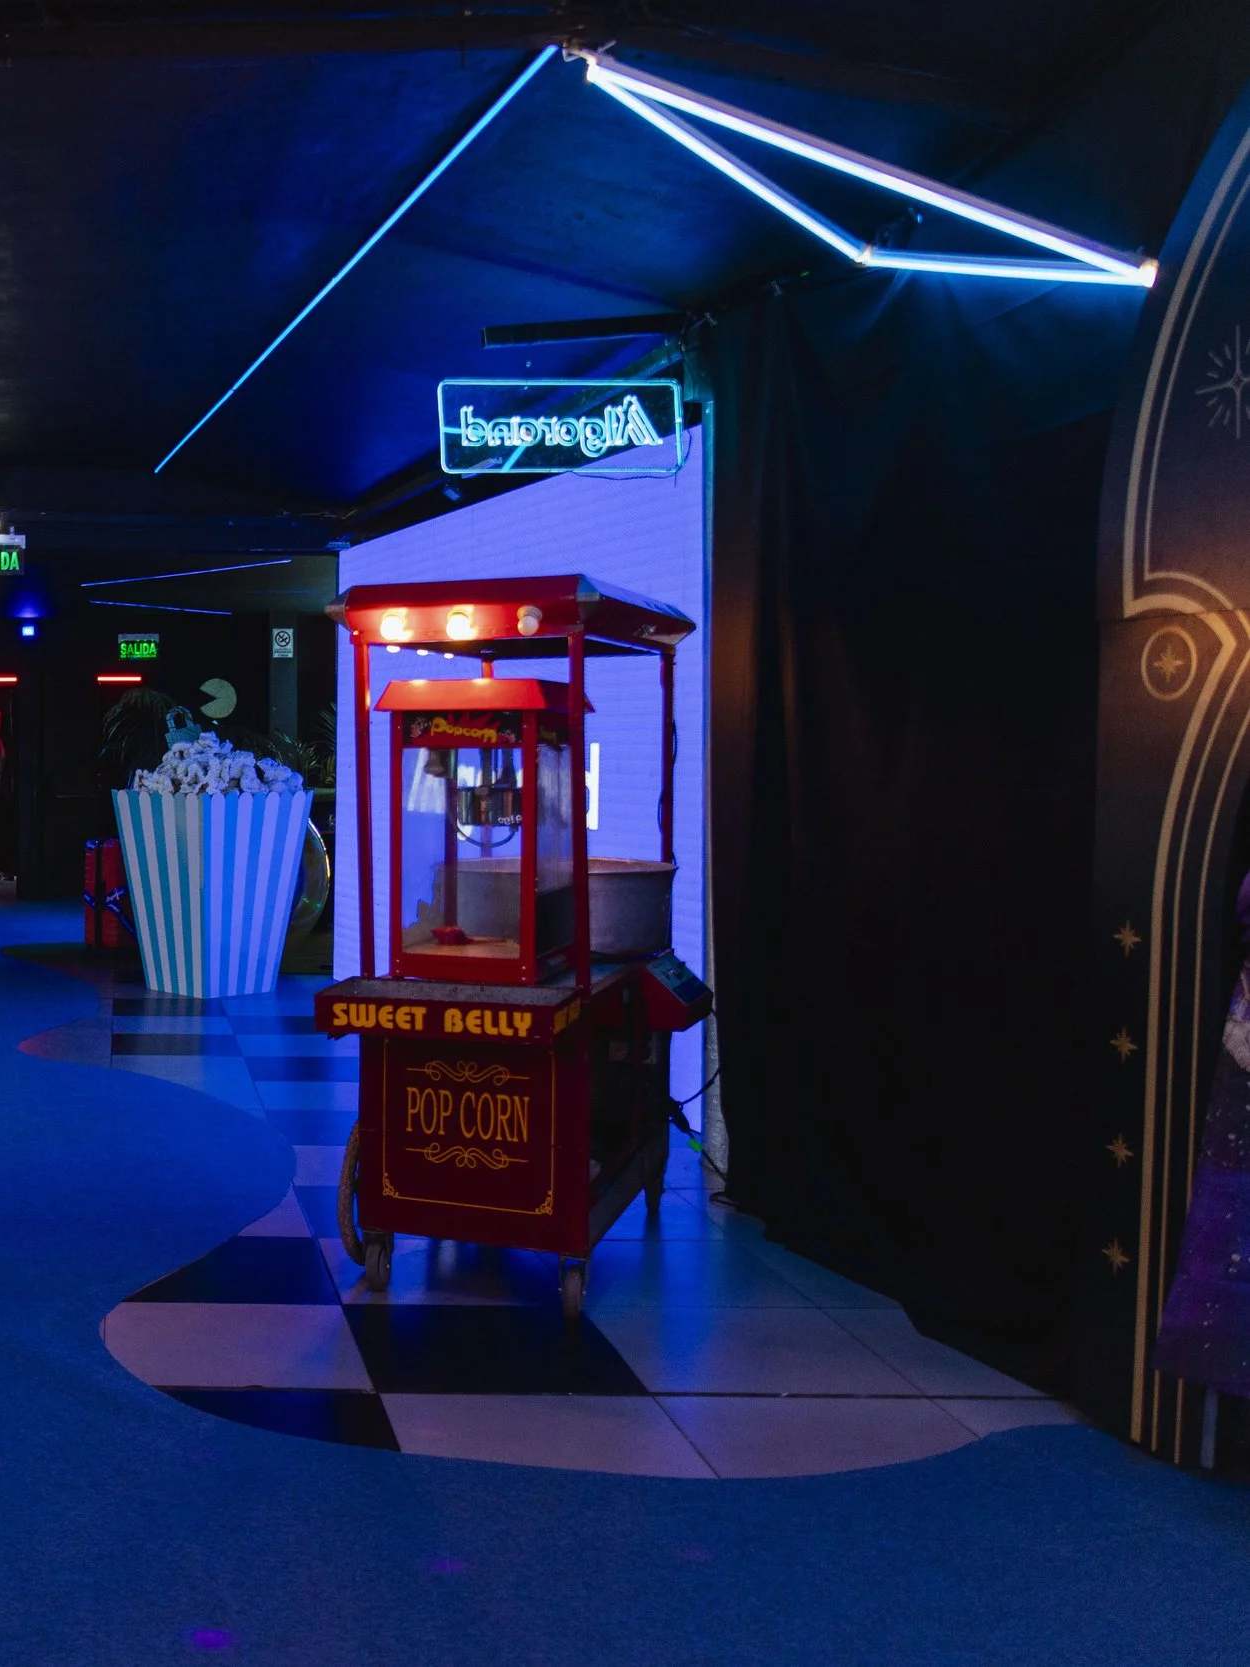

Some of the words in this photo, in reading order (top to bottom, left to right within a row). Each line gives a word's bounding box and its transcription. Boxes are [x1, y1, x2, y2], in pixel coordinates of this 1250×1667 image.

[120, 643, 157, 655] SALIDA
[430, 717, 498, 743] Popcorn
[332, 1003, 426, 1031] SWEET
[444, 1008, 533, 1037] BELLY
[406, 1087, 453, 1135] POP
[459, 1091, 530, 1143] CORN
